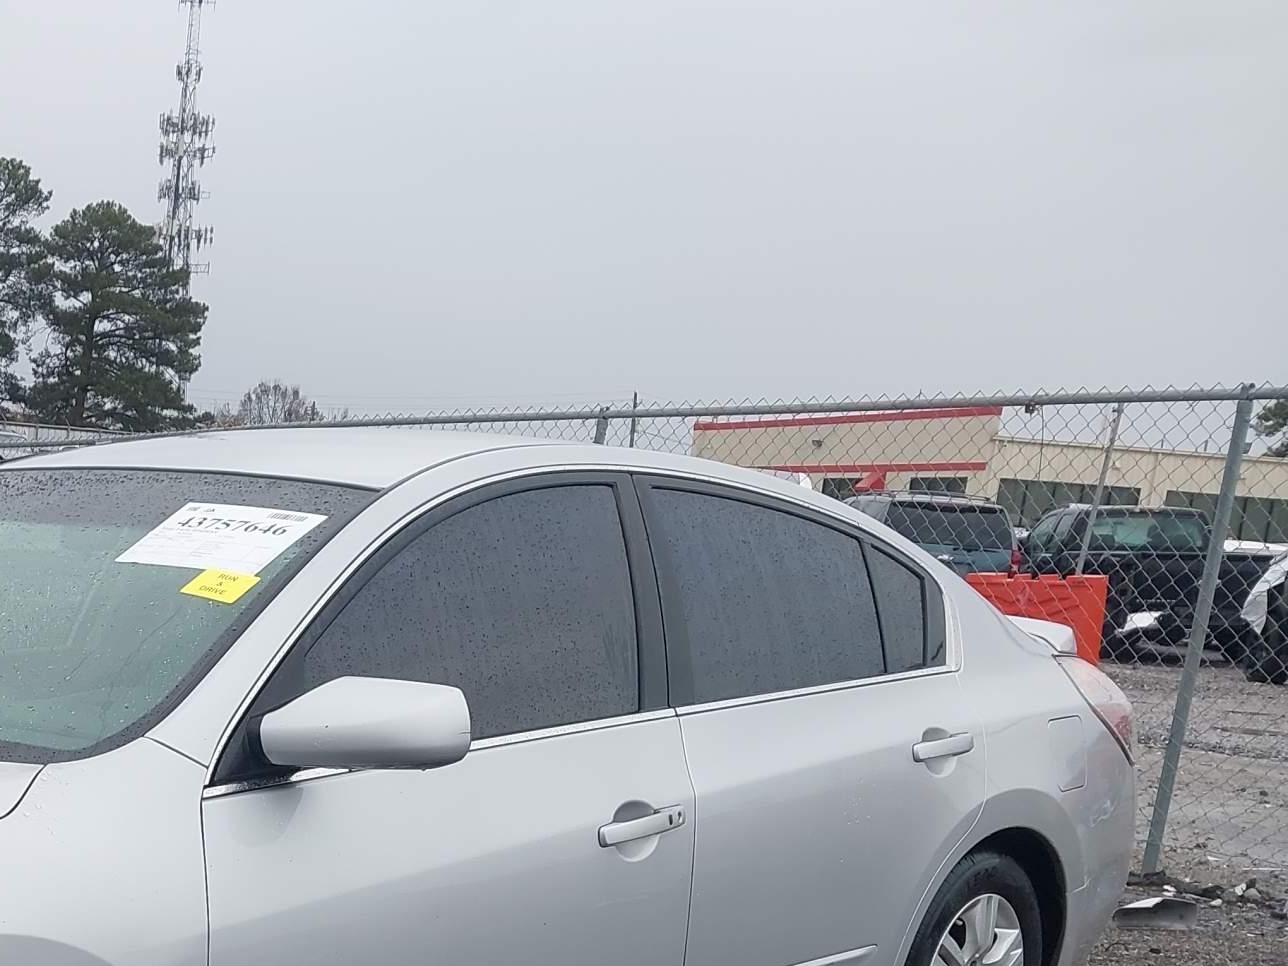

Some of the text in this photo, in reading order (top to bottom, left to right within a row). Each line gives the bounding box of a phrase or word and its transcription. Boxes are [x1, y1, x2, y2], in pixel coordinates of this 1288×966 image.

[178, 515, 293, 536] 43757646
[217, 573, 239, 582] RUN
[199, 584, 227, 595] DRIVE
